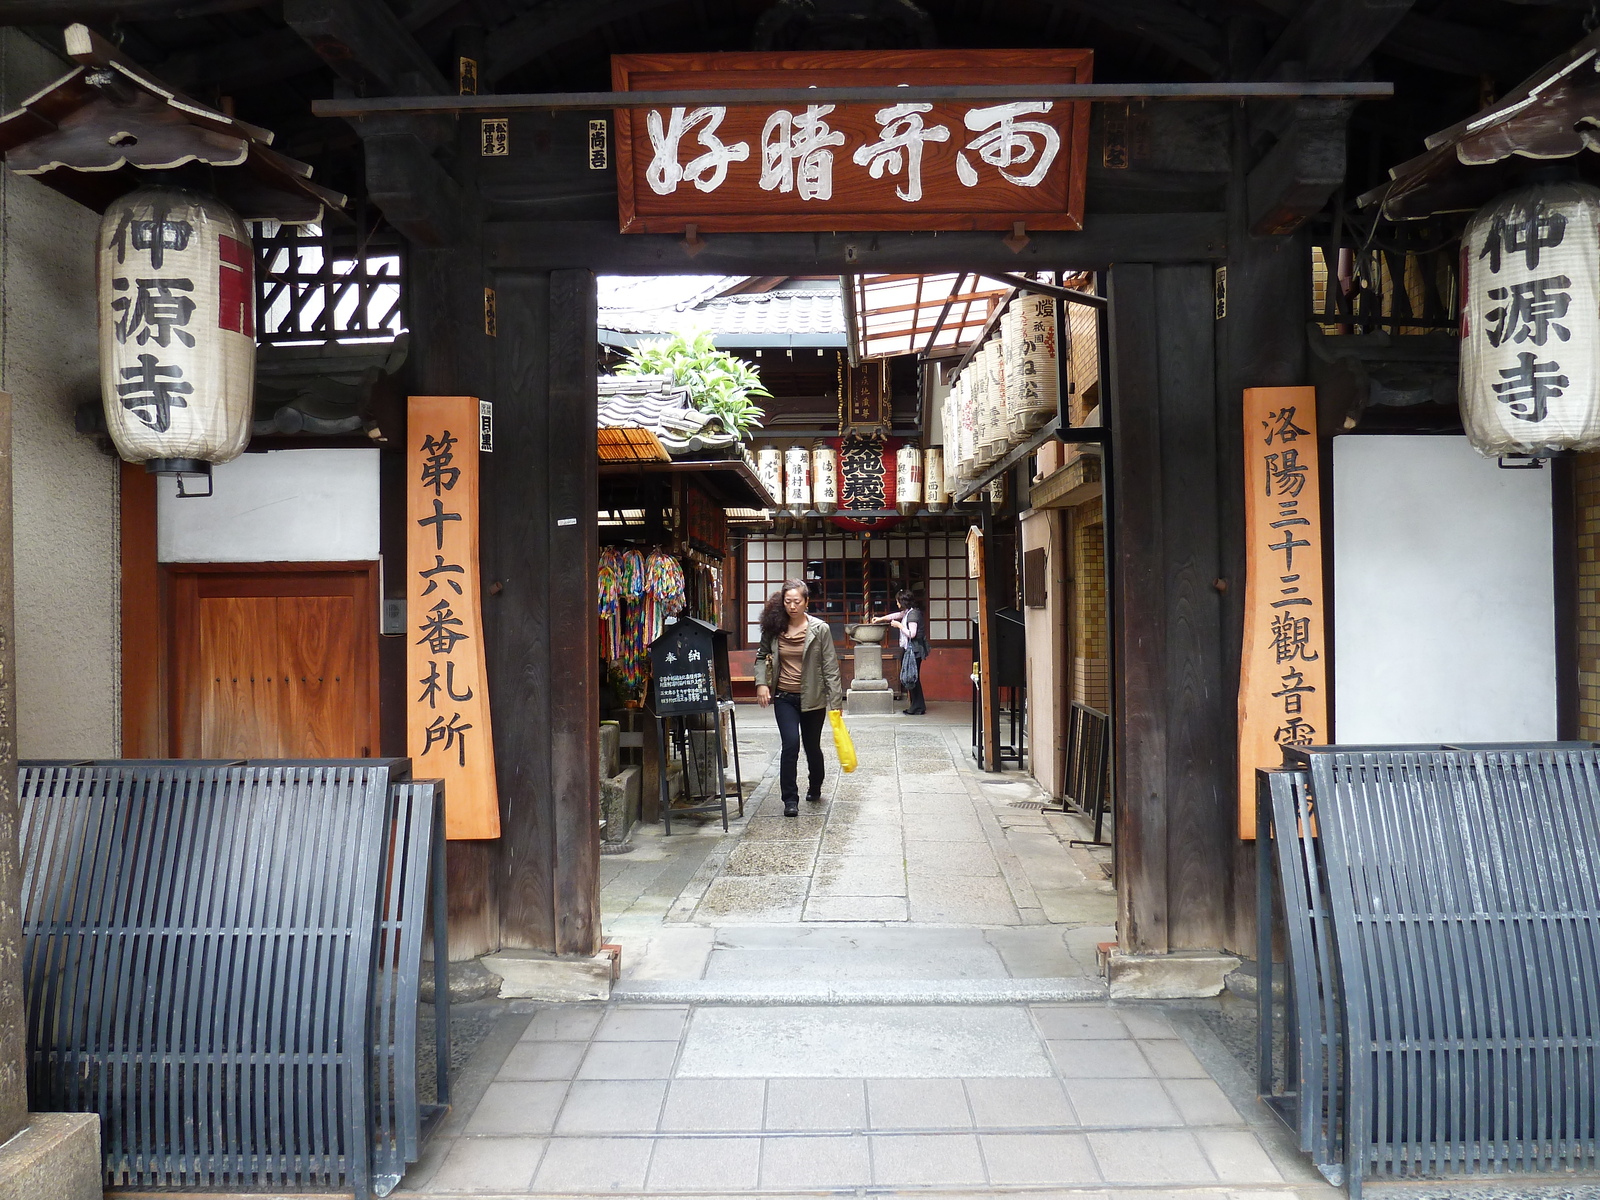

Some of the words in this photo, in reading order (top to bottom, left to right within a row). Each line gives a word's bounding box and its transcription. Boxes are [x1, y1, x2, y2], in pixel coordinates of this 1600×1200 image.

[109, 200, 197, 434] 仲源寺
[1478, 200, 1573, 424] 仲源寺
[415, 430, 474, 768] 第十六番札所
